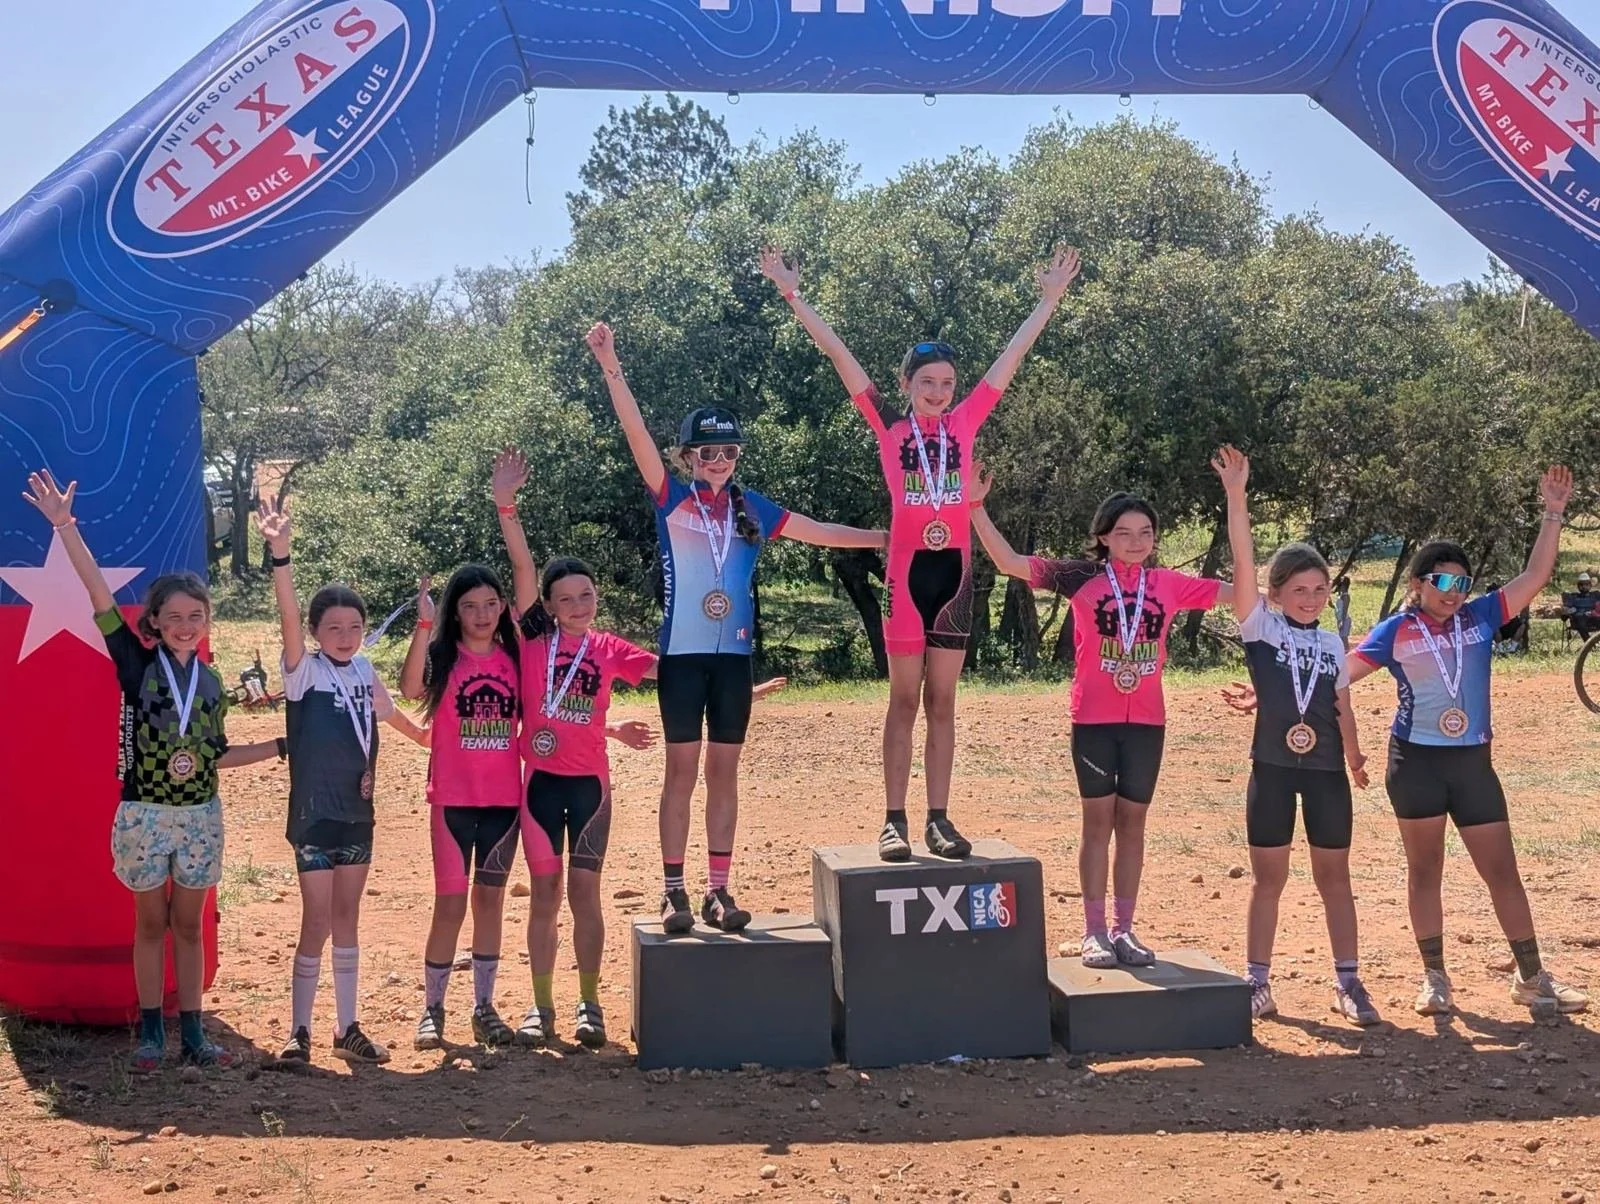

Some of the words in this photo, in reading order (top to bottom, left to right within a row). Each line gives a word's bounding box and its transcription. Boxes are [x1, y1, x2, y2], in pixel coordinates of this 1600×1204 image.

[144, 7, 378, 204] TEXAS
[161, 16, 324, 154] INTERSCHOLASTIC
[208, 196, 247, 220] MT.
[246, 166, 293, 203] BIKE
[327, 63, 389, 141] LEAGUE
[1476, 83, 1501, 117] MT.
[1496, 115, 1534, 156] BIKE
[904, 470, 962, 491] ALO
[661, 550, 672, 619] PRIMAL
[125, 704, 135, 771] COMPOSITE
[460, 718, 512, 737] ALAMO
[460, 736, 511, 750] FEMMES
[539, 703, 592, 725] FMMES
[875, 884, 969, 935] TX
[973, 887, 987, 926] NICA
